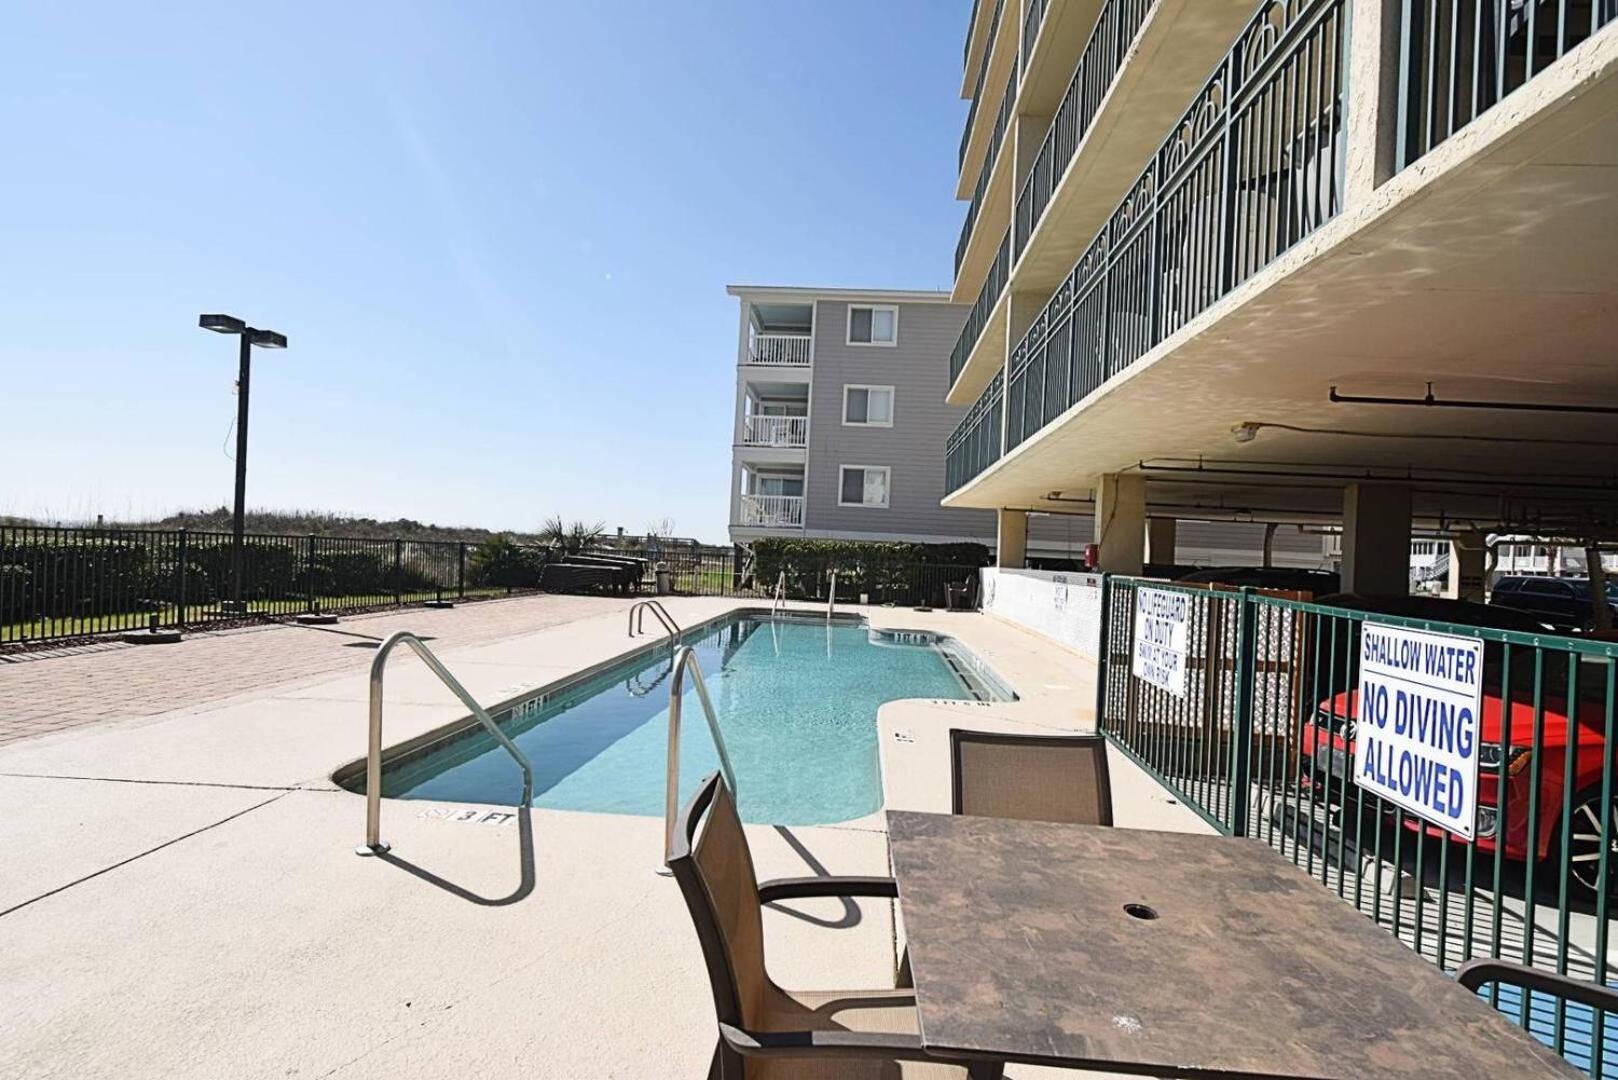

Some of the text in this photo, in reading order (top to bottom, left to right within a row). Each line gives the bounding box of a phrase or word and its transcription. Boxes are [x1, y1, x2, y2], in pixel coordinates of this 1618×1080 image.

[1148, 592, 1185, 623] LIFEGUARD
[1154, 620, 1174, 648] DUTY
[1364, 632, 1475, 685] SHALLOW WATER
[1363, 681, 1473, 759] NO DIVING
[1363, 737, 1464, 820] ALLOWED
[457, 811, 515, 824] 3 FT
